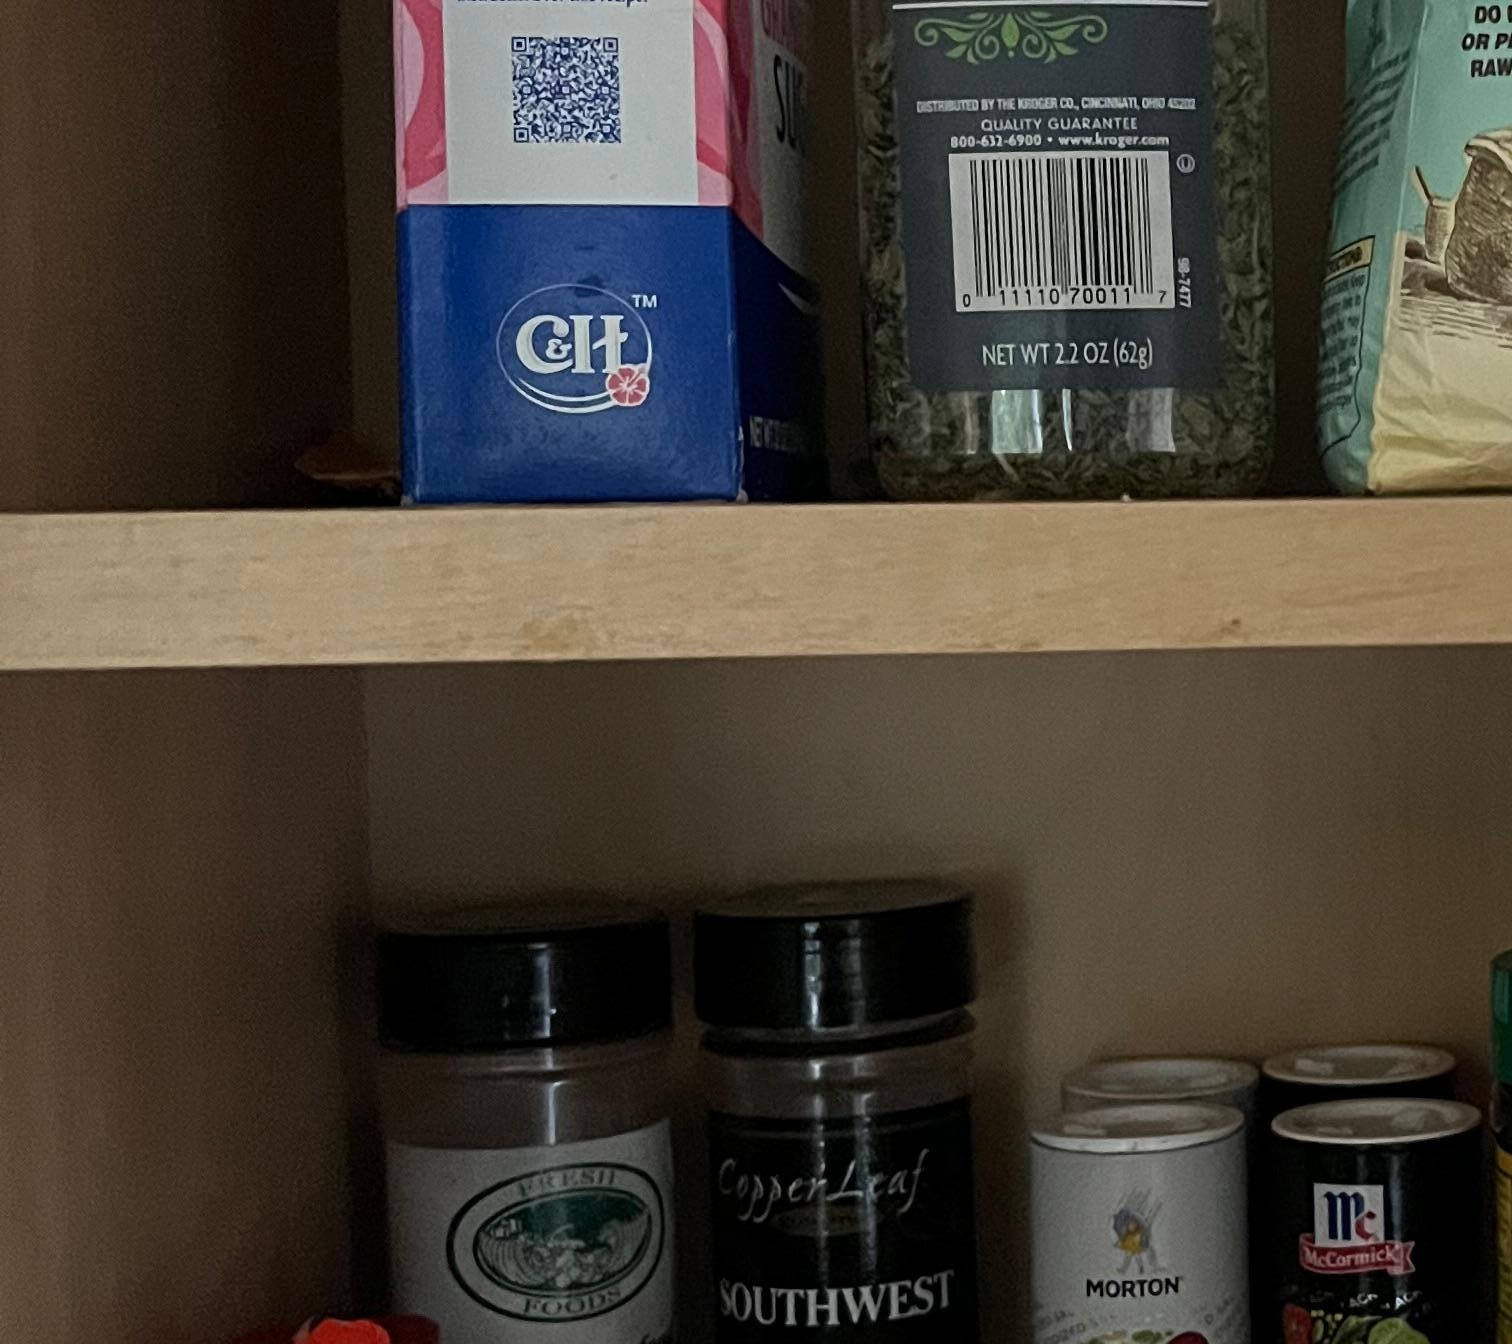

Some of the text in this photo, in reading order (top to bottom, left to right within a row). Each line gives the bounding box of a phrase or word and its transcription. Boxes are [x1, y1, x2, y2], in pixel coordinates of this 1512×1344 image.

[1474, 6, 1501, 24] DO
[1461, 33, 1490, 51] OR
[1470, 59, 1512, 78] RAW
[981, 117, 1137, 132] QUALITY GUARANTEE
[950, 133, 1169, 148] 800-632-6900 www.kroger.com
[962, 288, 1167, 308] 0 11110 70011 7
[515, 314, 629, 374] C&H
[982, 337, 1154, 370] NET WT 2.2 OZ (62g)
[516, 1167, 617, 1199] FRESH
[719, 1158, 827, 1223] Copper
[825, 1147, 930, 1215] Leaf
[1302, 1243, 1398, 1269] McCormick
[719, 1269, 955, 1327] SOUTHWEST
[1086, 1278, 1179, 1299] MORTON
[522, 1286, 623, 1317] FOODS
